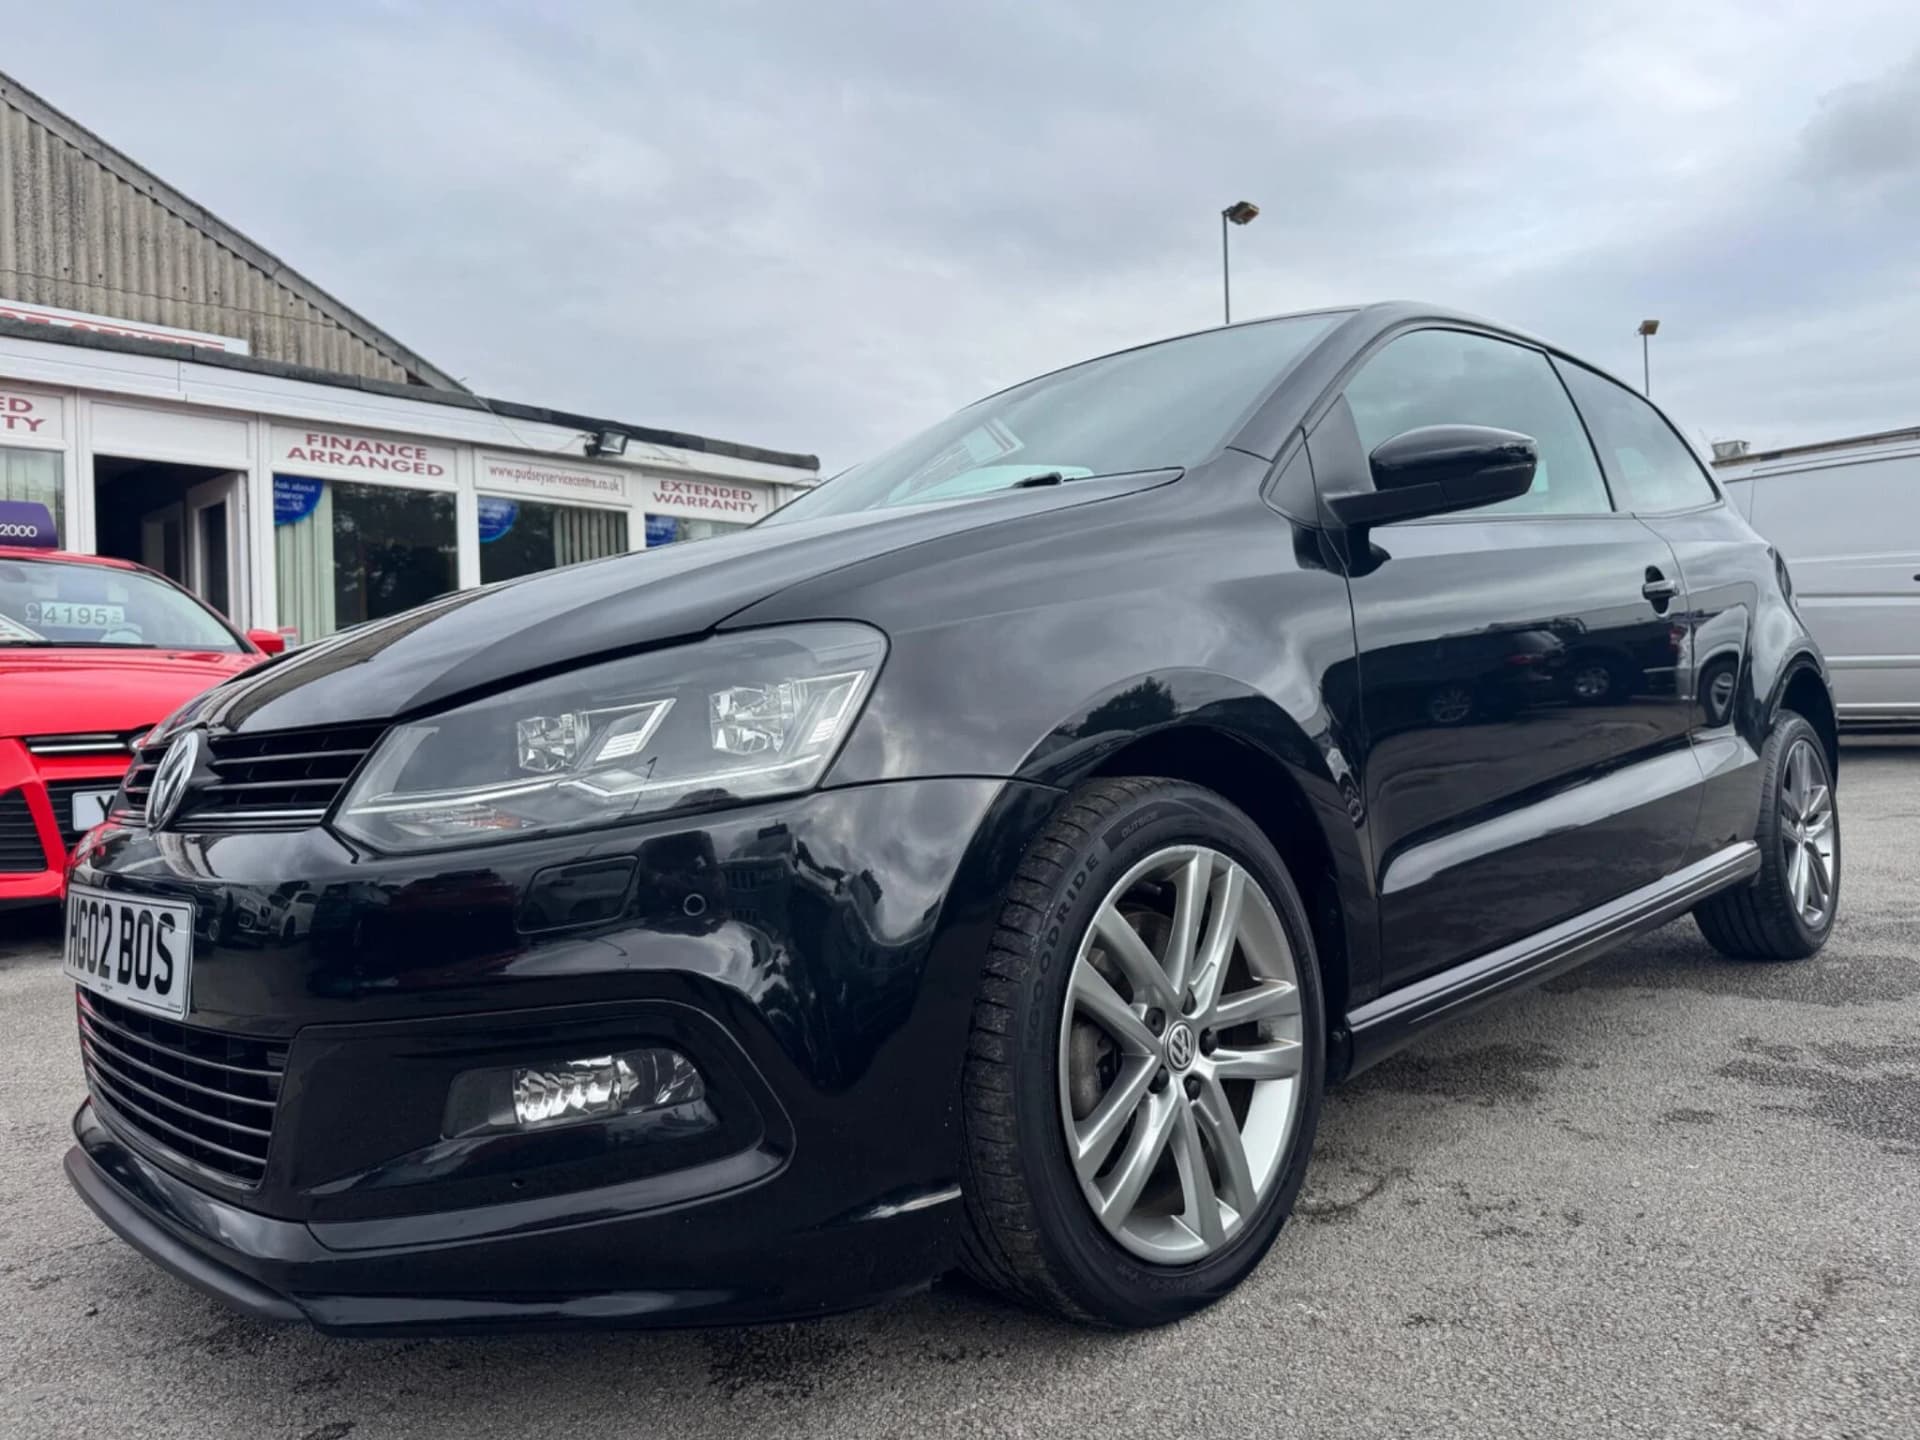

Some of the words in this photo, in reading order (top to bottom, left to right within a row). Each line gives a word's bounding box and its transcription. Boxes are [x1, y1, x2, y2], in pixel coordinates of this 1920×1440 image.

[287, 446, 444, 476] ARRANGED
[306, 433, 427, 461] FINANCE
[489, 465, 619, 491] www.pudseyservicecentre.co.uk
[660, 480, 752, 500] EXTENDED
[652, 491, 758, 513] WARRANTY
[117, 905, 176, 996] BOS
[1029, 853, 1099, 1030] GOODRIDE
